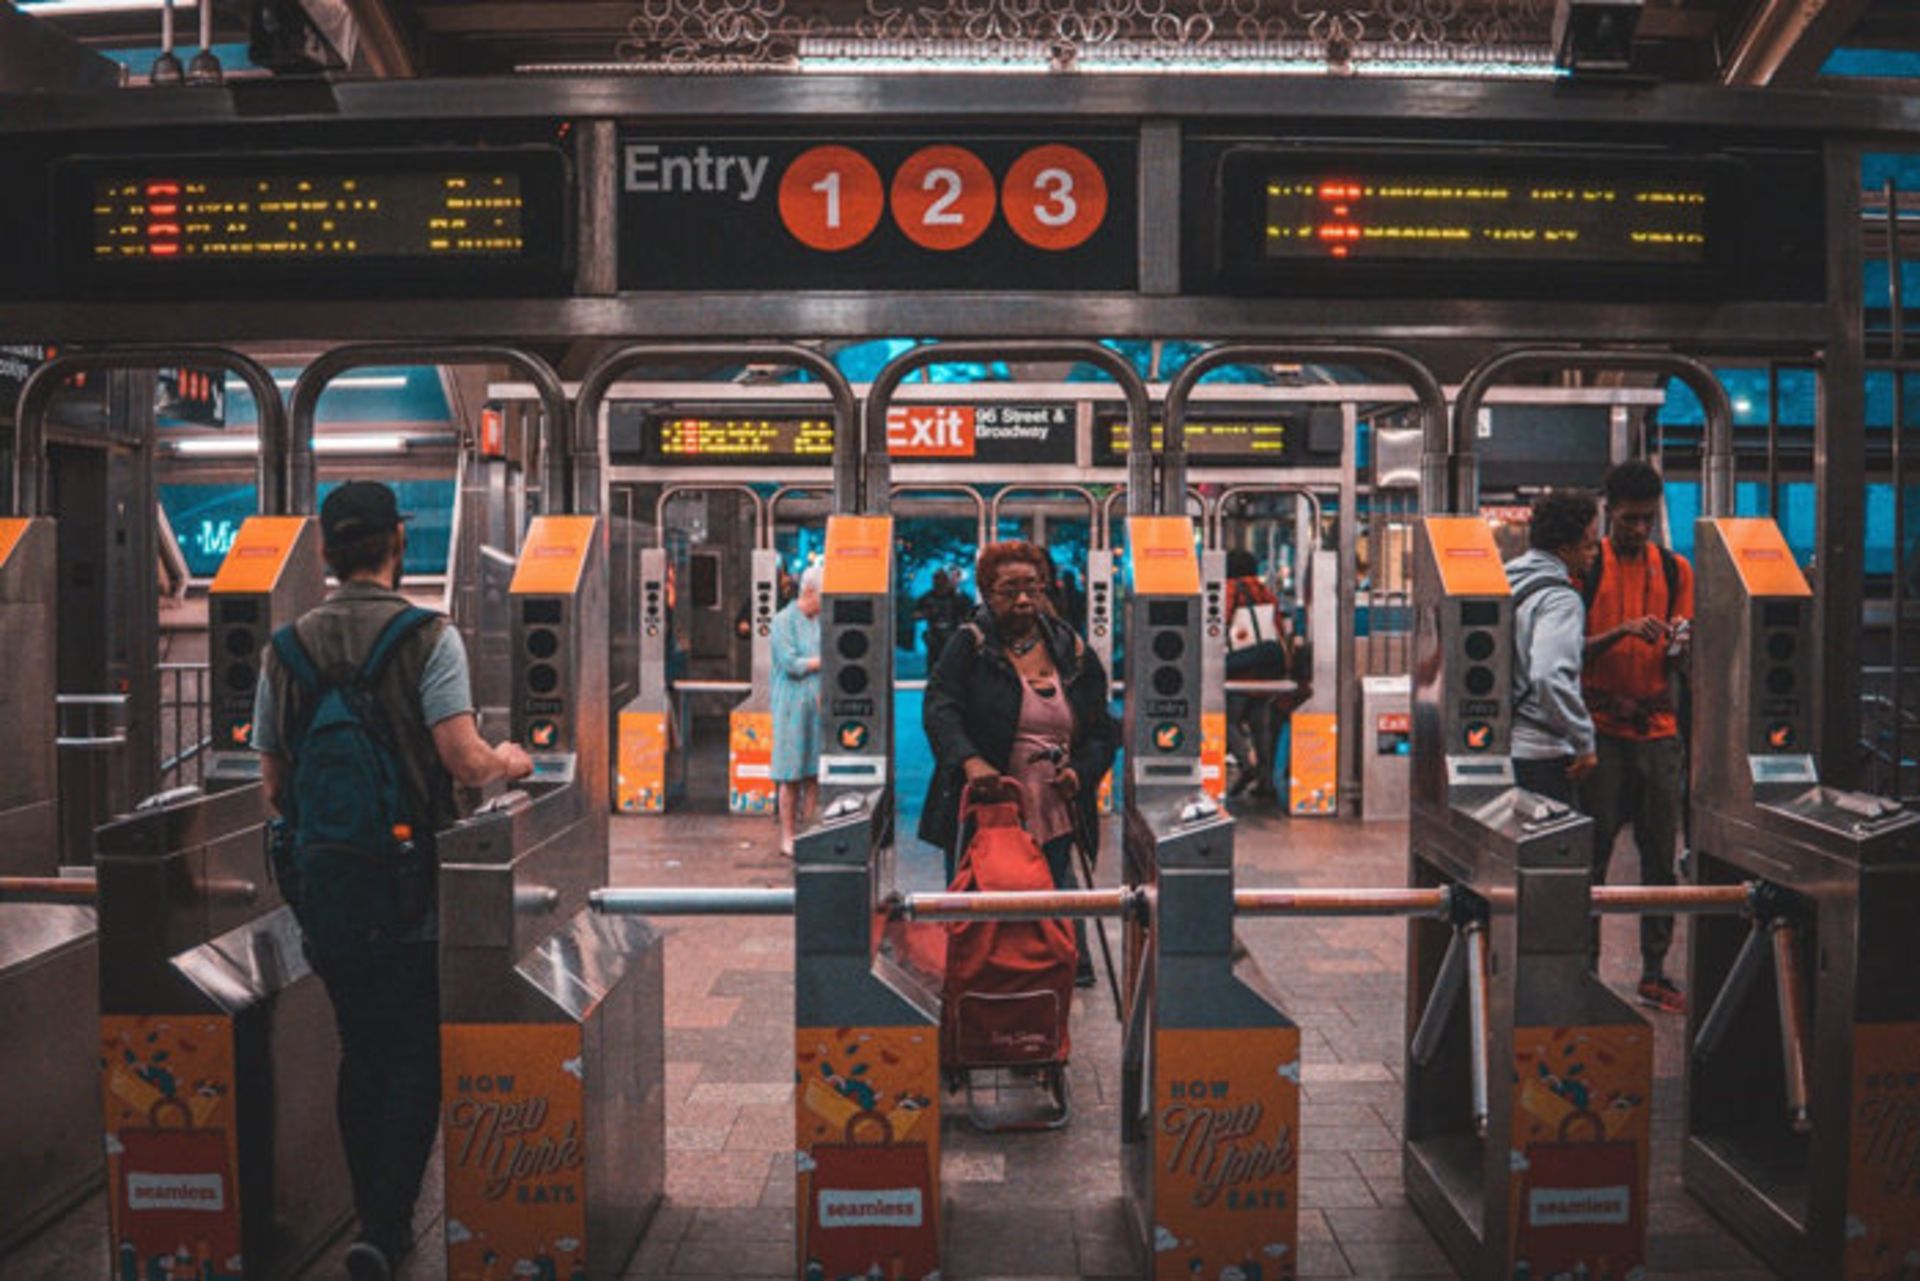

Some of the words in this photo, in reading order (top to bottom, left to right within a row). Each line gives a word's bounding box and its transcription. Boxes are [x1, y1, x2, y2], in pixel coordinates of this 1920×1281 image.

[625, 145, 769, 201] Entry
[812, 172, 840, 228] 1
[922, 168, 965, 226] 2
[1033, 168, 1078, 227] 3
[975, 408, 996, 423] 96
[1001, 408, 1049, 423] Street
[1053, 408, 1066, 423] &
[886, 408, 965, 447] Exit
[975, 425, 1049, 440] Broadway
[833, 702, 870, 716] Entry
[1148, 702, 1185, 717] Entry
[456, 1075, 515, 1093] HOW
[1170, 1081, 1229, 1099] HOW
[449, 1098, 549, 1168] New
[1161, 1102, 1264, 1174] New
[482, 1120, 585, 1200] York
[1188, 1125, 1297, 1208] York
[134, 1184, 217, 1200] seamless
[516, 1184, 577, 1205] EATS
[1227, 1188, 1287, 1211] EATS
[827, 1200, 914, 1217] seamless
[1535, 1197, 1622, 1214] seamless
